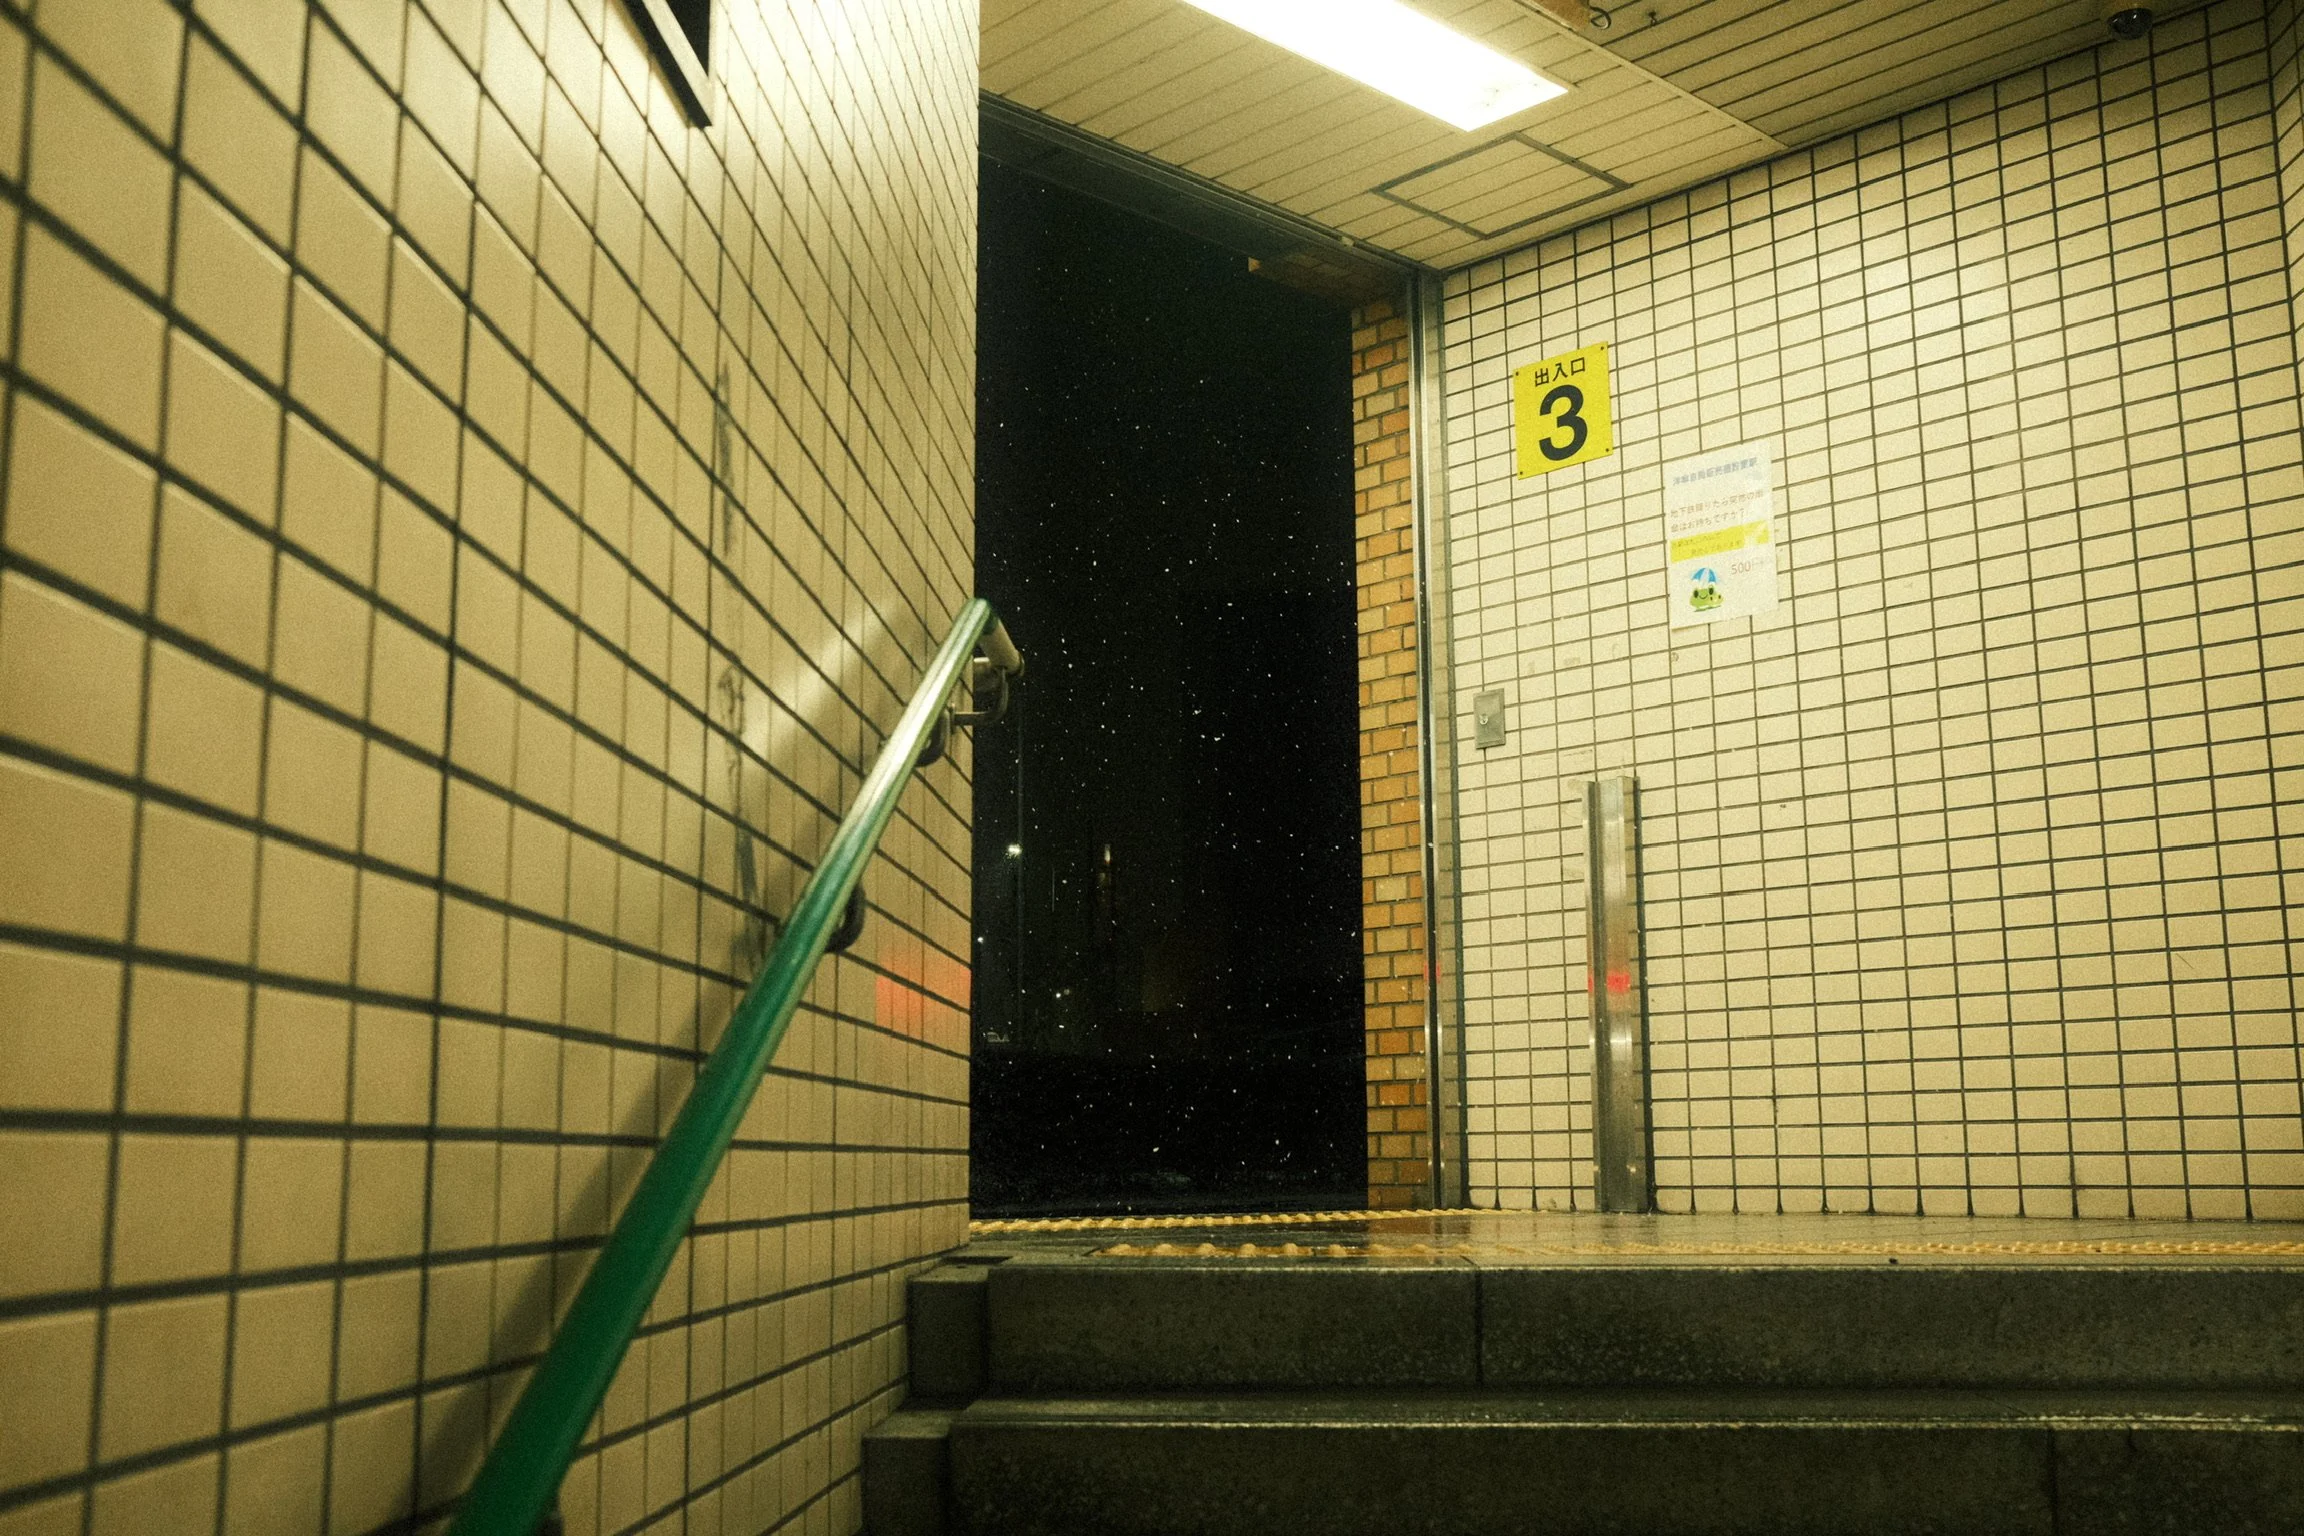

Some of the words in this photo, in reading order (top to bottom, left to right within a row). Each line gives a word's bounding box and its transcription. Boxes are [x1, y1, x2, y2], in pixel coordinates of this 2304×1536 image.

[1534, 356, 1586, 387] 出入口
[1538, 384, 1588, 461] 3
